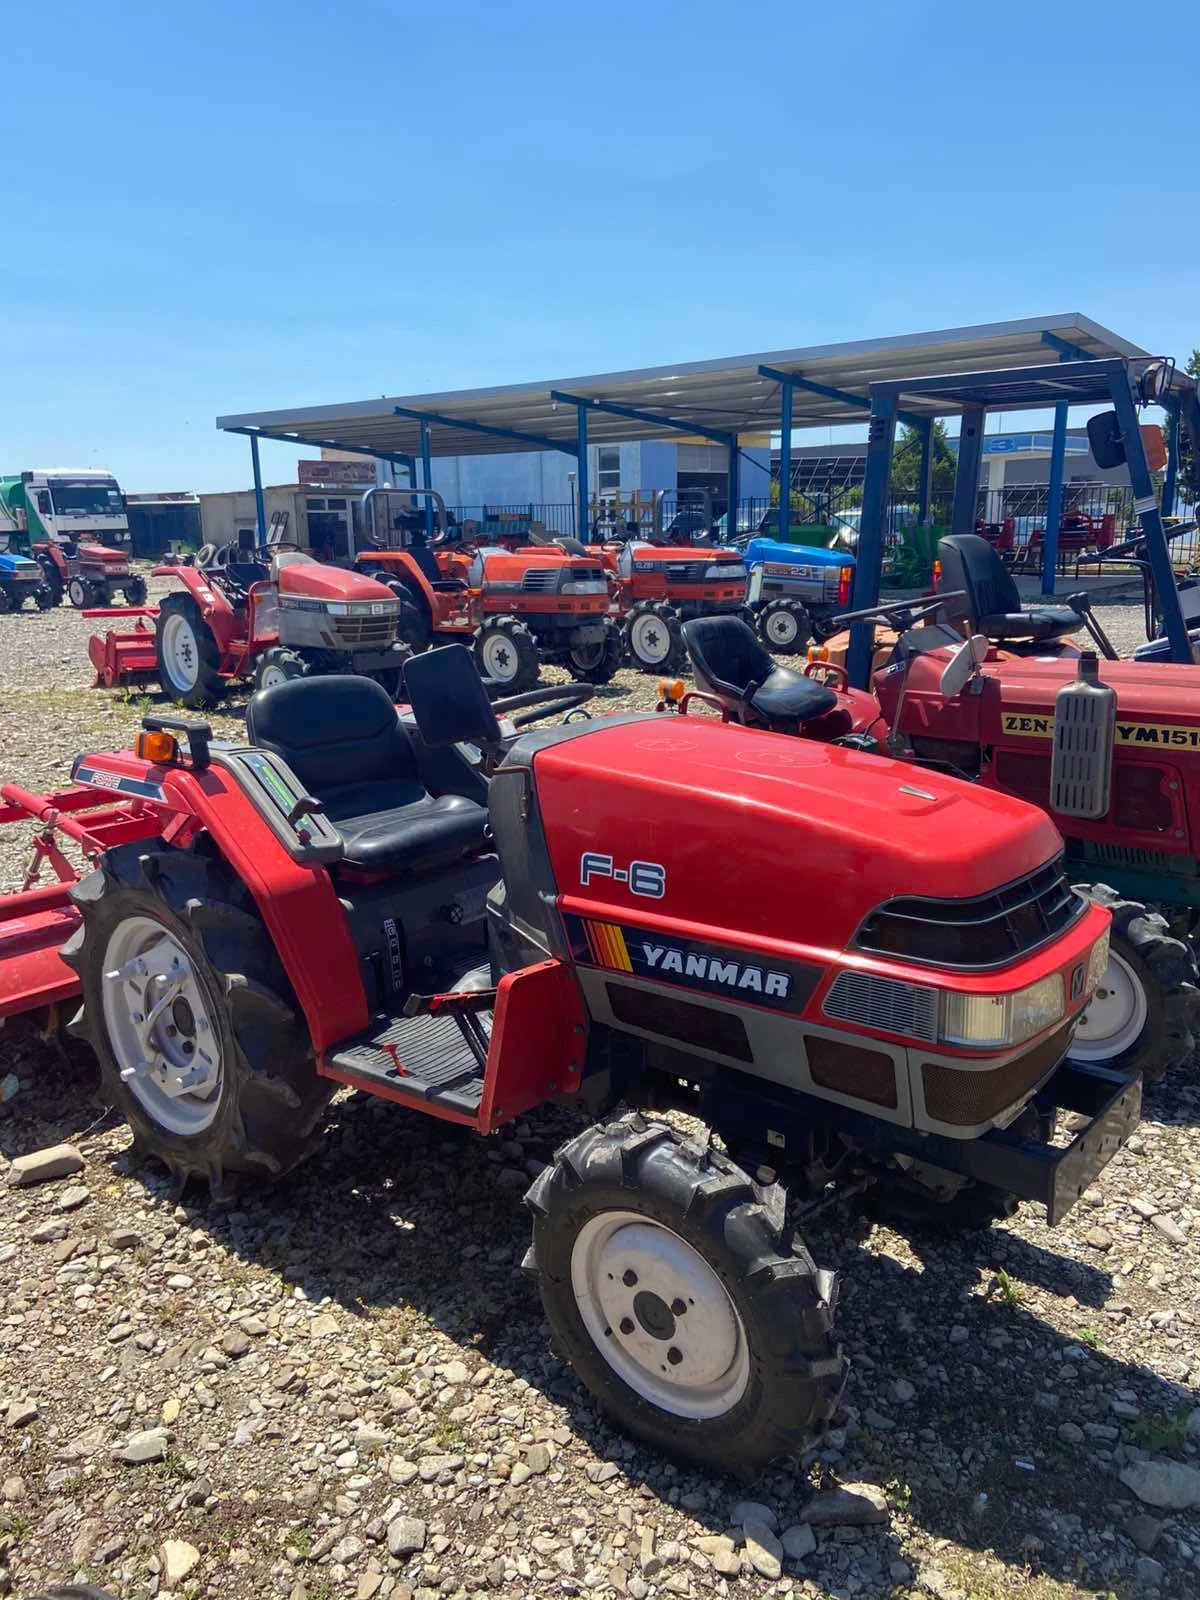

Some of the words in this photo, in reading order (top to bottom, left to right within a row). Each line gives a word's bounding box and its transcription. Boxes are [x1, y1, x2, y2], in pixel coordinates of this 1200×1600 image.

[1004, 716, 1055, 733] ZEN-
[1117, 725, 1200, 746] YM151
[91, 772, 121, 790] FORTE
[579, 852, 666, 899] F-6
[641, 943, 792, 998] YANMAR
